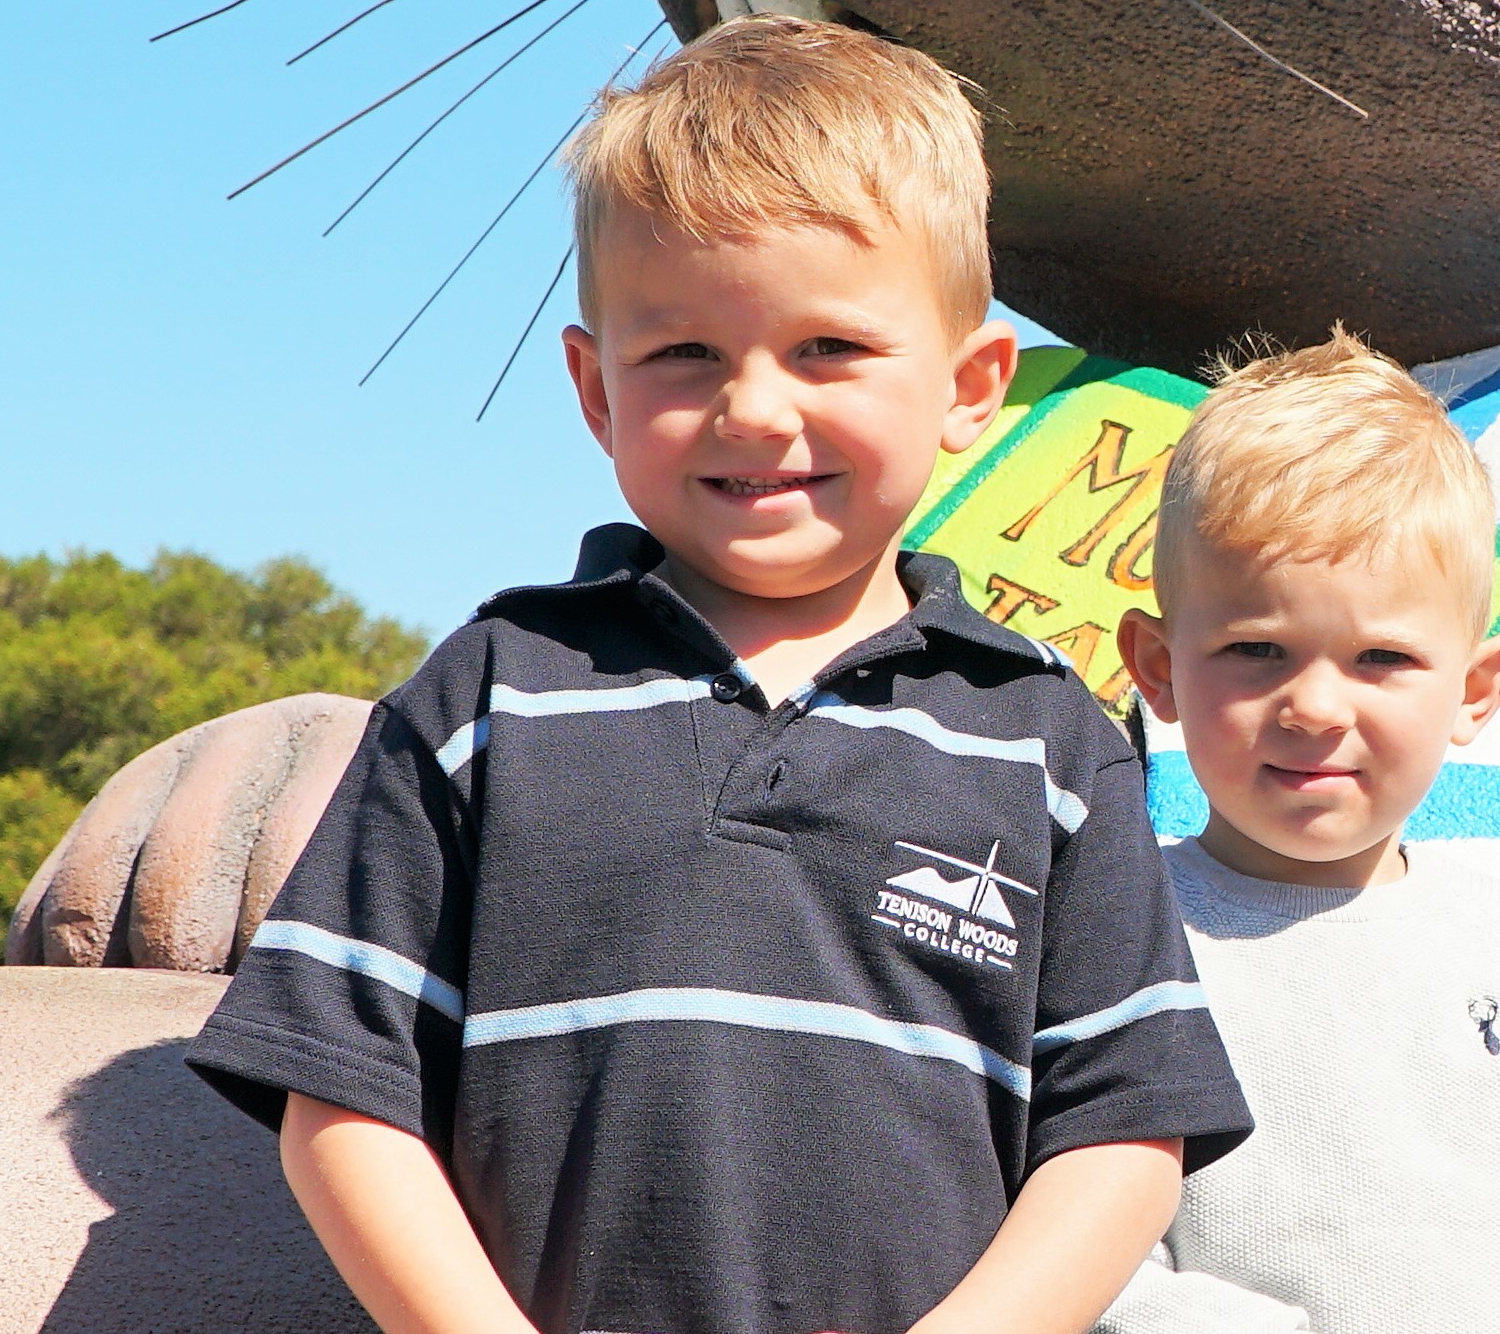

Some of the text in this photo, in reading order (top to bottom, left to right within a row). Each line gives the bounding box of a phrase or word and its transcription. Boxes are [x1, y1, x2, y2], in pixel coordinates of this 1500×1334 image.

[877, 890, 1019, 957] TENISON WOODS
[903, 922, 986, 964] COLLEGE
